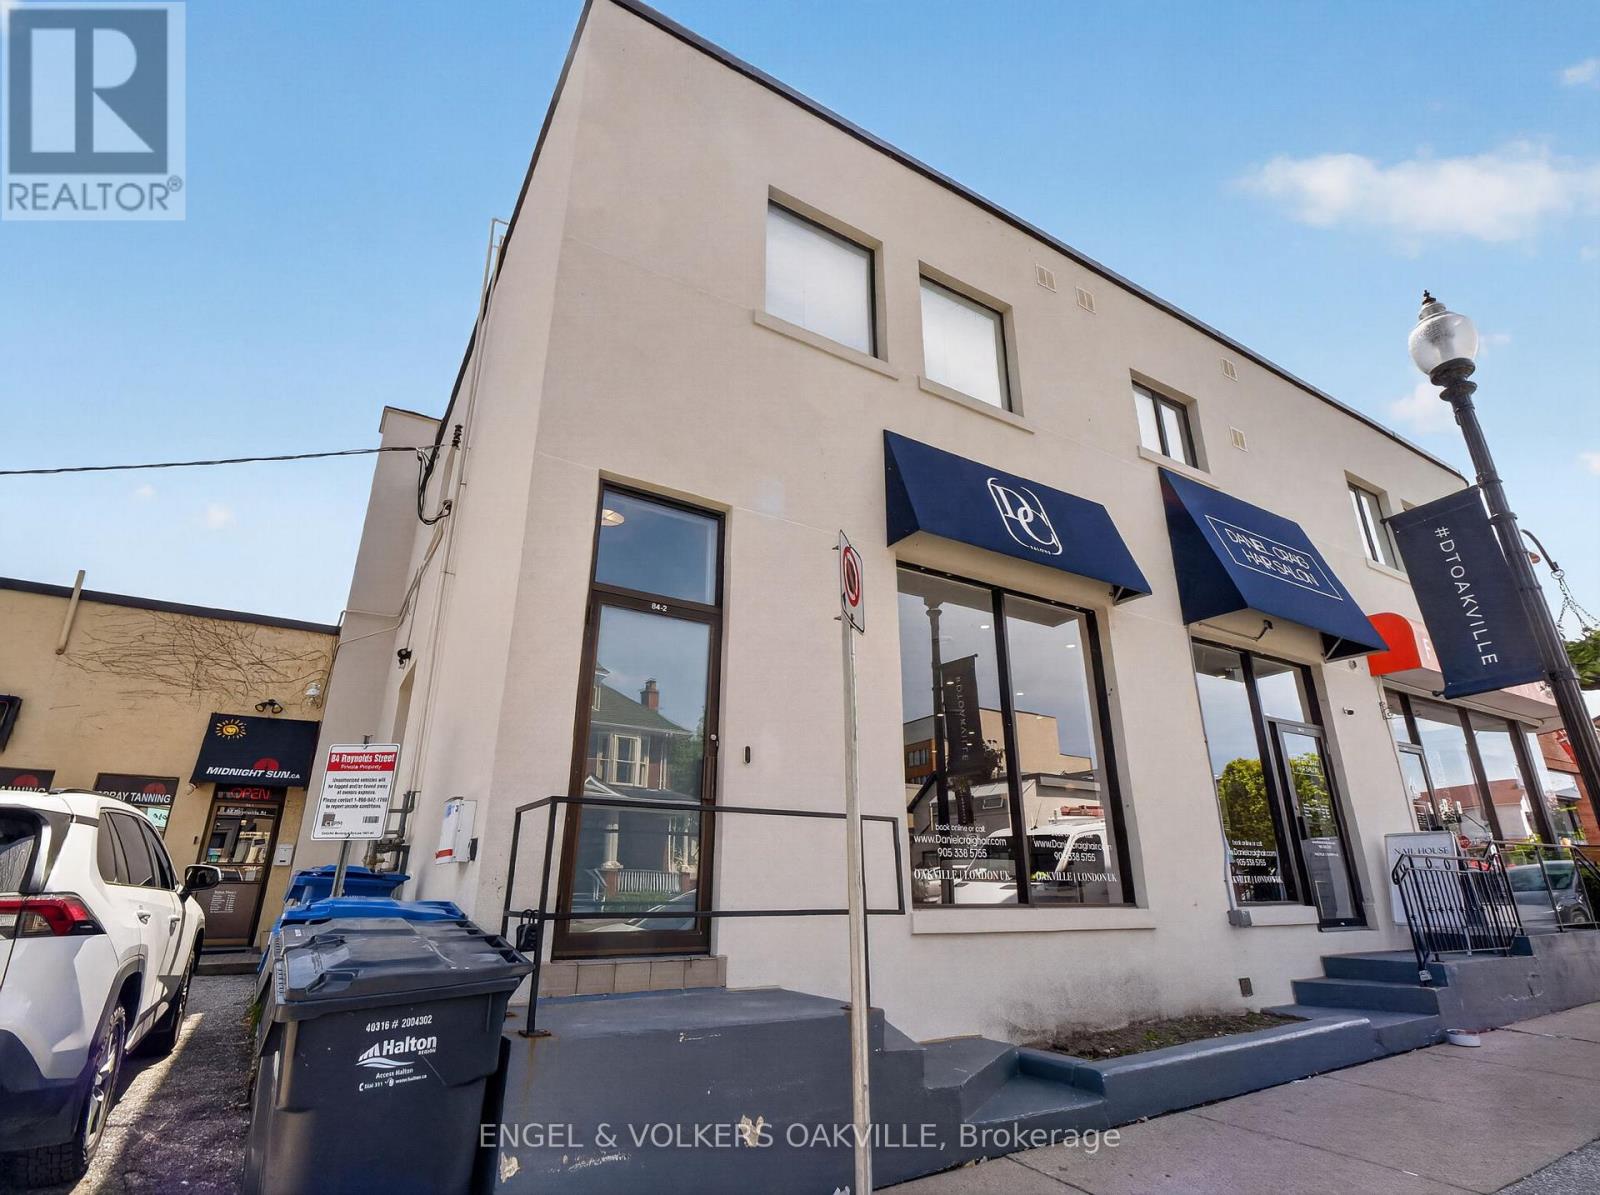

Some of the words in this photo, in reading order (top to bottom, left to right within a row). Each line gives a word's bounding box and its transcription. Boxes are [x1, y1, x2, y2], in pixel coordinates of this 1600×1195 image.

[1224, 528, 1276, 557] DANIEL
[1271, 546, 1310, 570] CRAIG
[1241, 548, 1277, 571] HAIR
[1272, 559, 1320, 587] SALON
[1434, 526, 1498, 666] #DTOAKVILLE
[651, 602, 668, 612] 84-2
[341, 754, 373, 764] Reynolds
[374, 753, 395, 763] Street
[206, 766, 265, 778] MIDNIGHT
[97, 790, 129, 801] PRAY
[130, 792, 171, 803] TANNING
[231, 787, 270, 800] OPEN
[935, 823, 950, 831] book
[951, 824, 968, 832] online
[913, 834, 1007, 846] www.Danielcraighair.com
[937, 848, 953, 857] 905
[954, 848, 968, 858] 338
[969, 848, 987, 858] 5755
[1418, 846, 1449, 854] HOUSE
[914, 868, 958, 880] OAKVILLE
[964, 869, 999, 880] LONDON
[1000, 869, 1012, 880] UK
[1036, 871, 1073, 881] OAKVILLE
[1077, 872, 1106, 882] LONDON
[366, 1020, 390, 1032] 40316
[391, 1019, 399, 1029] #
[401, 1015, 433, 1028] 2004302
[382, 1036, 437, 1056] Halton
[375, 1071, 395, 1080] Access
[395, 1068, 414, 1076] Halton
